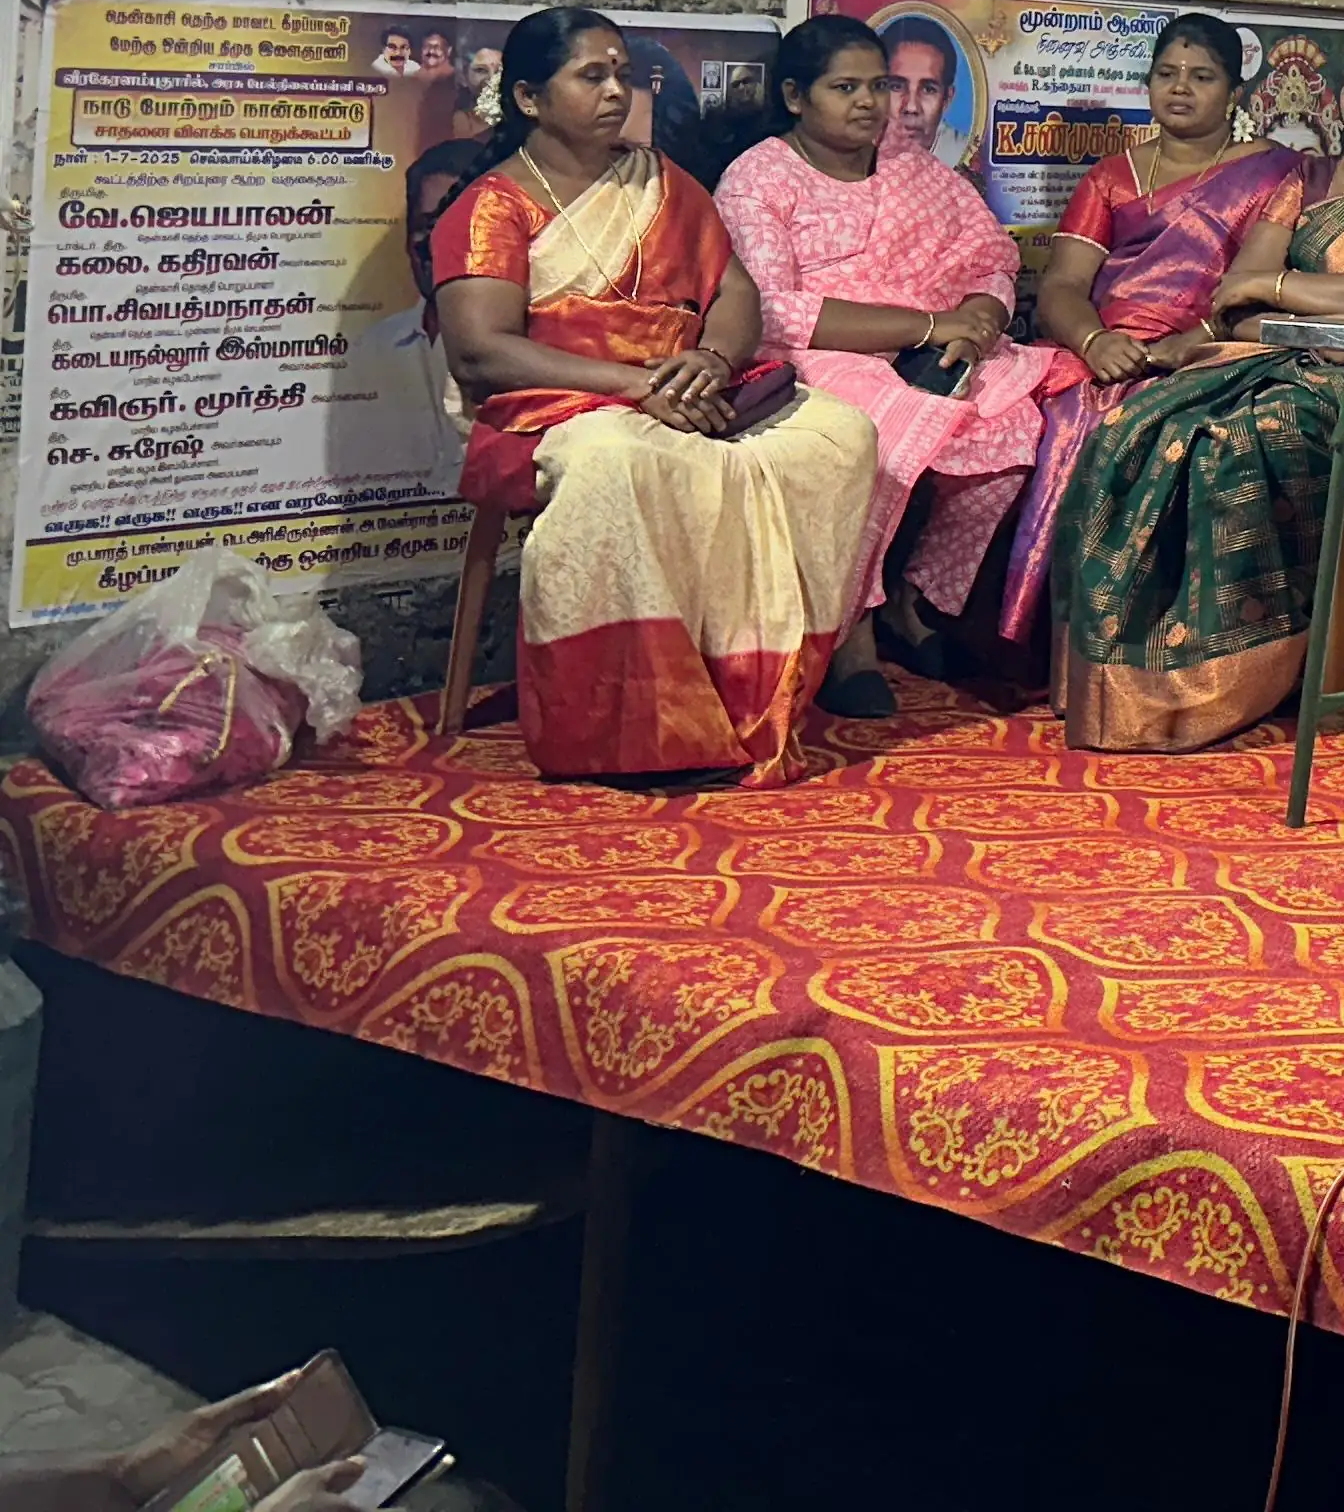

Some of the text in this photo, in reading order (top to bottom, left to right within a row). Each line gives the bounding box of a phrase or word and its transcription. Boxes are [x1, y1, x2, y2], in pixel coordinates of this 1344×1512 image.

[105, 8, 349, 37] தென்காசி தெற்கு மாவட்ட கீழப்பாவூர்
[1019, 7, 1103, 34] மூன்றாம்
[110, 36, 347, 61] மேற்கு ஒன்றிய திமுக இளைஞரணி
[211, 78, 245, 90] அரசு
[83, 97, 365, 123] நாடு போற்றும் நான்காண்டு
[94, 123, 352, 145] சாதனை விளக்க பொதுக்கூட்டம்
[53, 149, 88, 168] நாள்
[103, 151, 181, 165] 1-7-2025
[307, 153, 340, 166] 6.00
[343, 151, 394, 169] மணிக்கு
[58, 198, 336, 229] வே.ஜெயபாலன்
[56, 254, 150, 276] கலை.
[47, 291, 317, 326] பொ.சிவபத்மநாதன்
[51, 332, 349, 374] கடையநல்லூர் இஸ்மாயில்
[50, 390, 187, 422] கவிஞர்.
[194, 382, 307, 418] மூர்த்தி
[47, 447, 100, 465] செ.
[107, 434, 205, 461] சுரேஷ்
[44, 515, 111, 533] வருக!!
[114, 508, 177, 527] வருக!!
[182, 501, 243, 521] வருக!!
[246, 499, 282, 514] என
[98, 565, 181, 592] கீழப்பா
[298, 544, 380, 571] ஒன்றிய
[383, 537, 439, 561] திமுக
